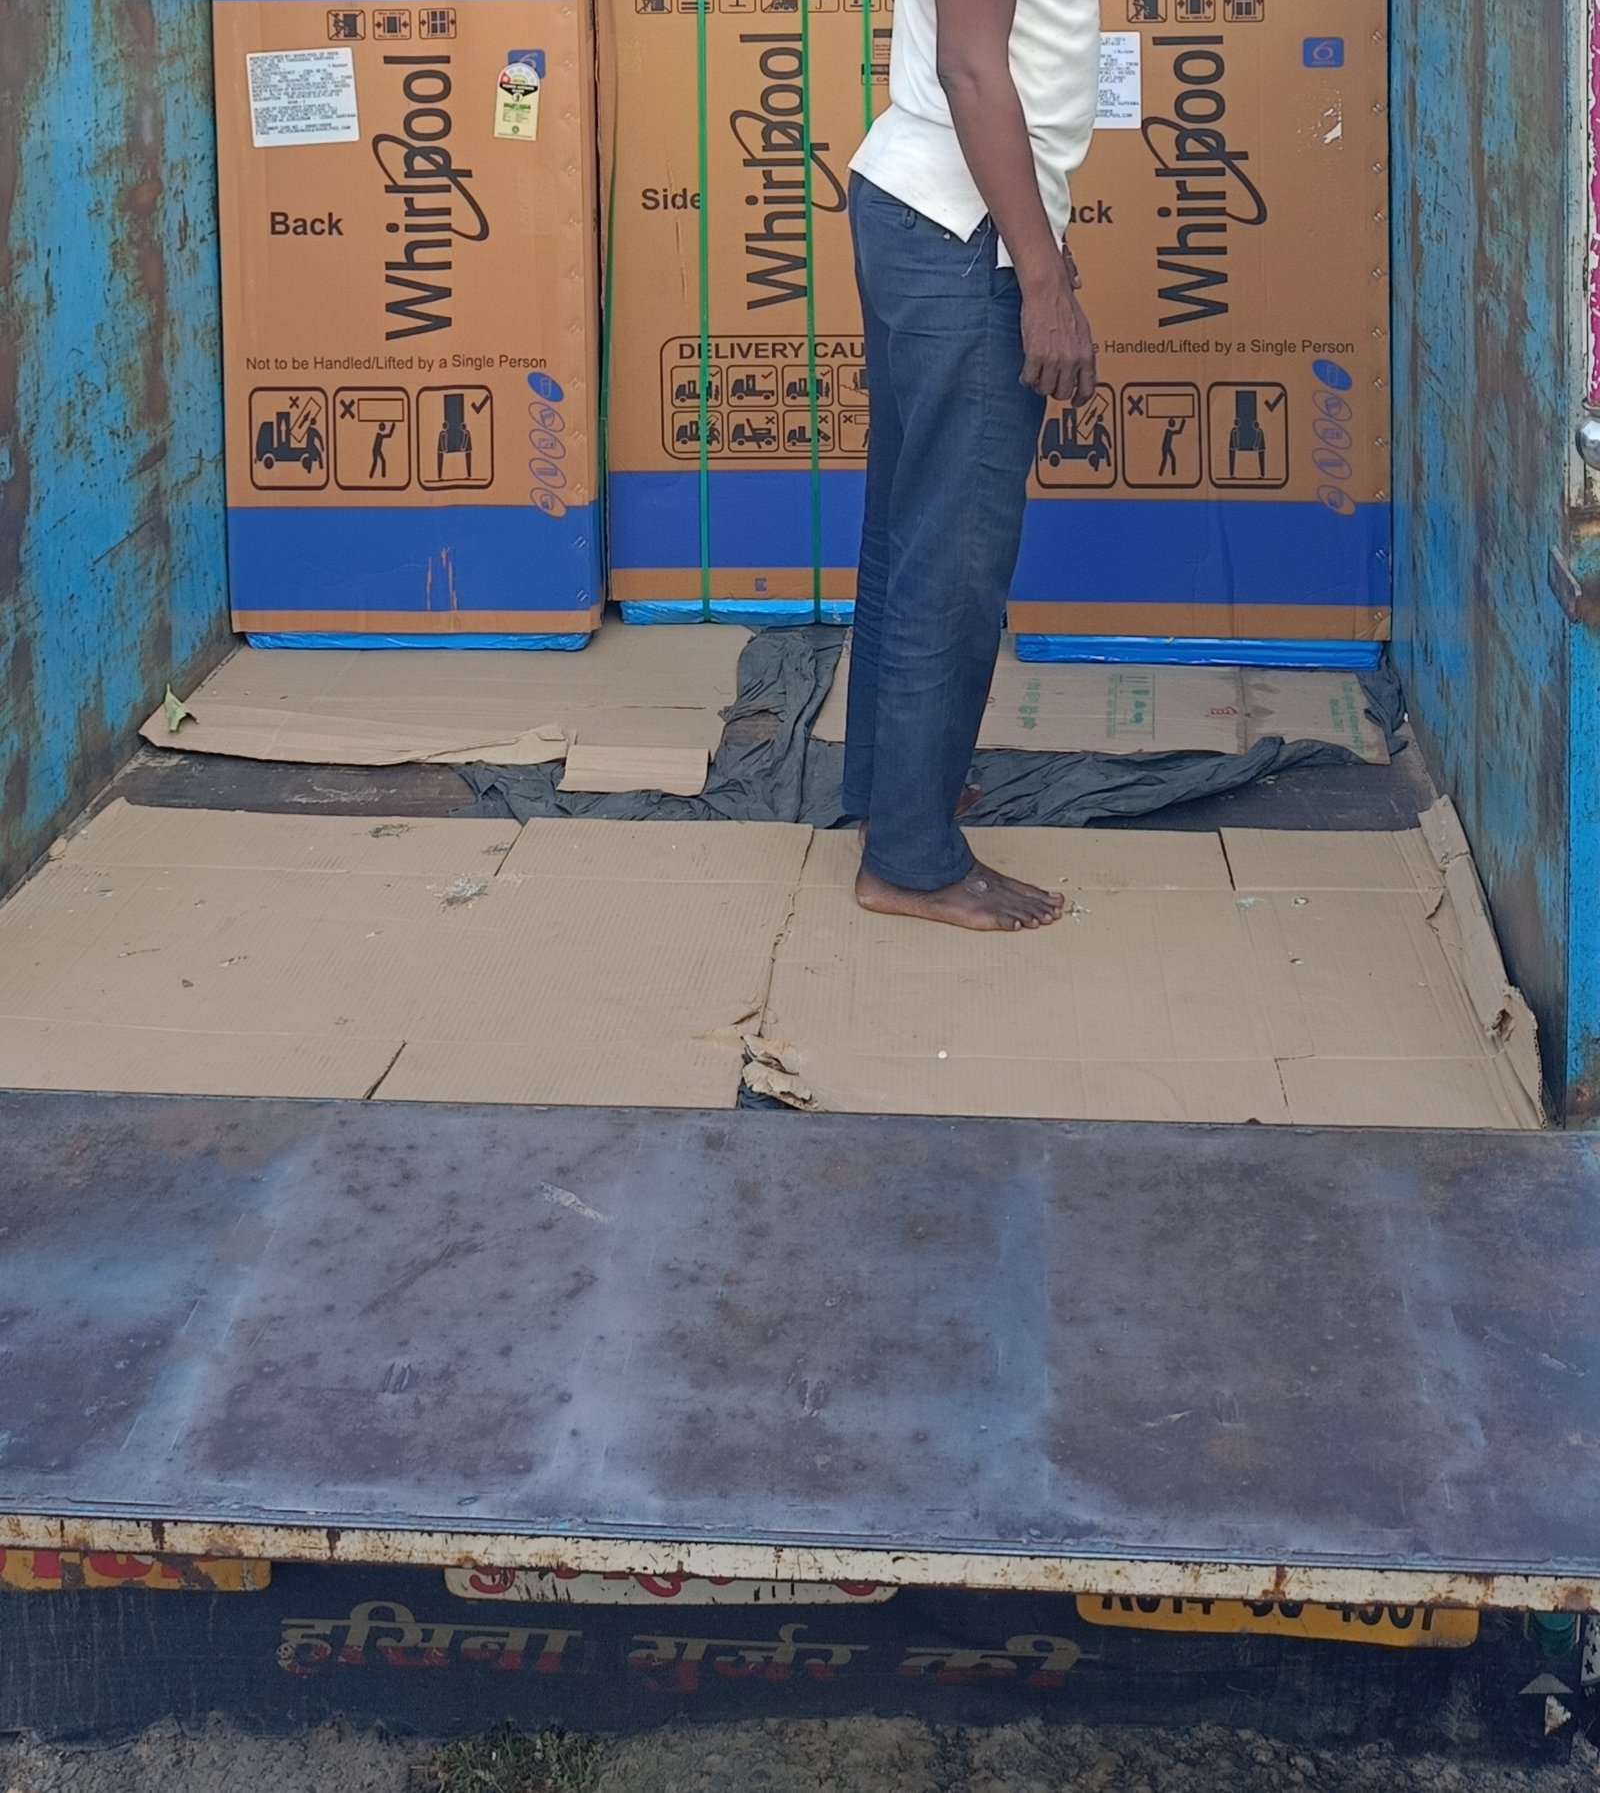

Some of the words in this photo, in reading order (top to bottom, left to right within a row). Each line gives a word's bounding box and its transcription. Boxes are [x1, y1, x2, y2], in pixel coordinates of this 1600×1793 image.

[739, 32, 831, 311] Whirlpool
[1151, 34, 1249, 328] Whirlpool
[383, 54, 473, 342] Whirlpool
[641, 187, 701, 210] Side
[270, 211, 344, 236] Back
[1069, 199, 1114, 224] ck
[1104, 339, 1210, 354] Handled/Lifted
[1214, 339, 1231, 357] by
[1236, 342, 1246, 354] a
[1250, 338, 1297, 357] Single
[1301, 339, 1355, 354] Person
[246, 356, 271, 370] Not
[275, 356, 288, 370] to
[292, 355, 309, 370] be
[313, 355, 414, 371] Handled/Lifted
[418, 356, 435, 373] by
[439, 358, 448, 369] a
[451, 353, 495, 371] Single
[499, 354, 547, 370] Person
